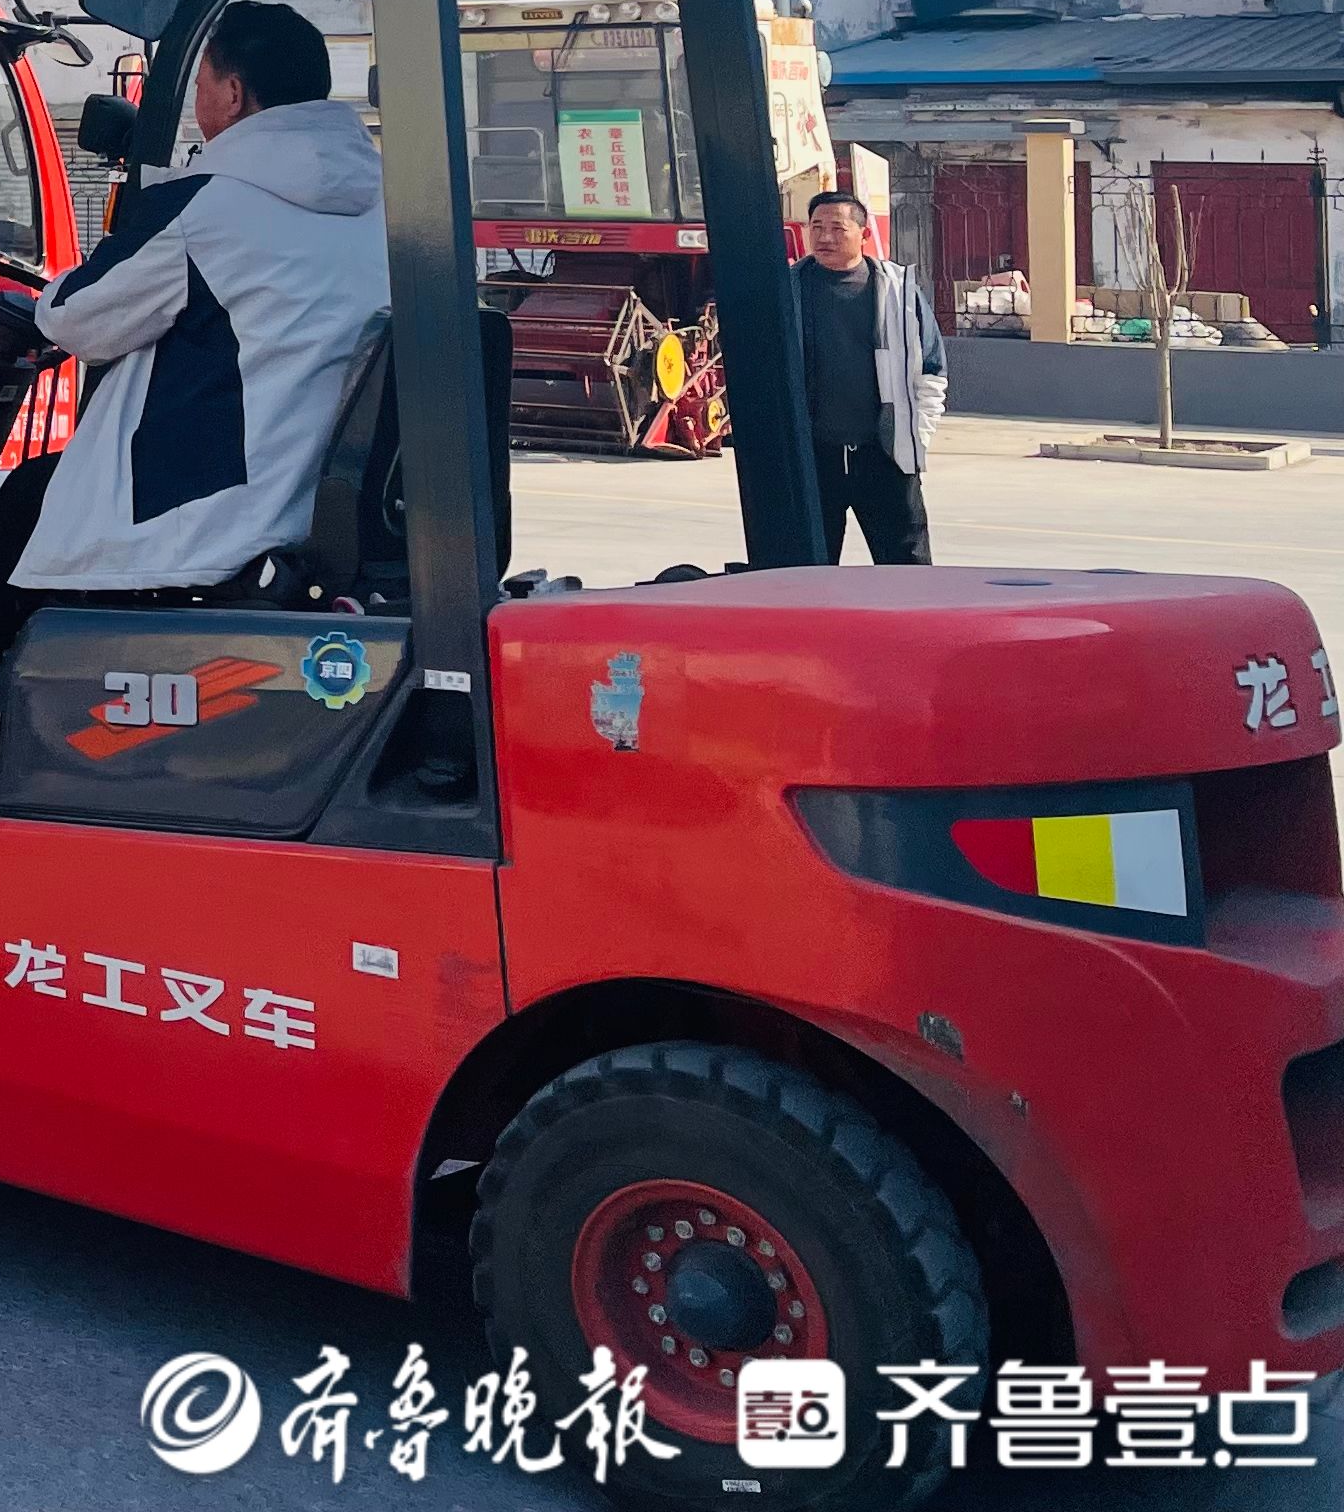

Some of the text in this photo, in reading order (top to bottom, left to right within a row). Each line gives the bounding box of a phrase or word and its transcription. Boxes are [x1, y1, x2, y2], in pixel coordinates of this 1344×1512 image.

[104, 671, 199, 726] 30
[3, 937, 317, 1050] 龙工叉车
